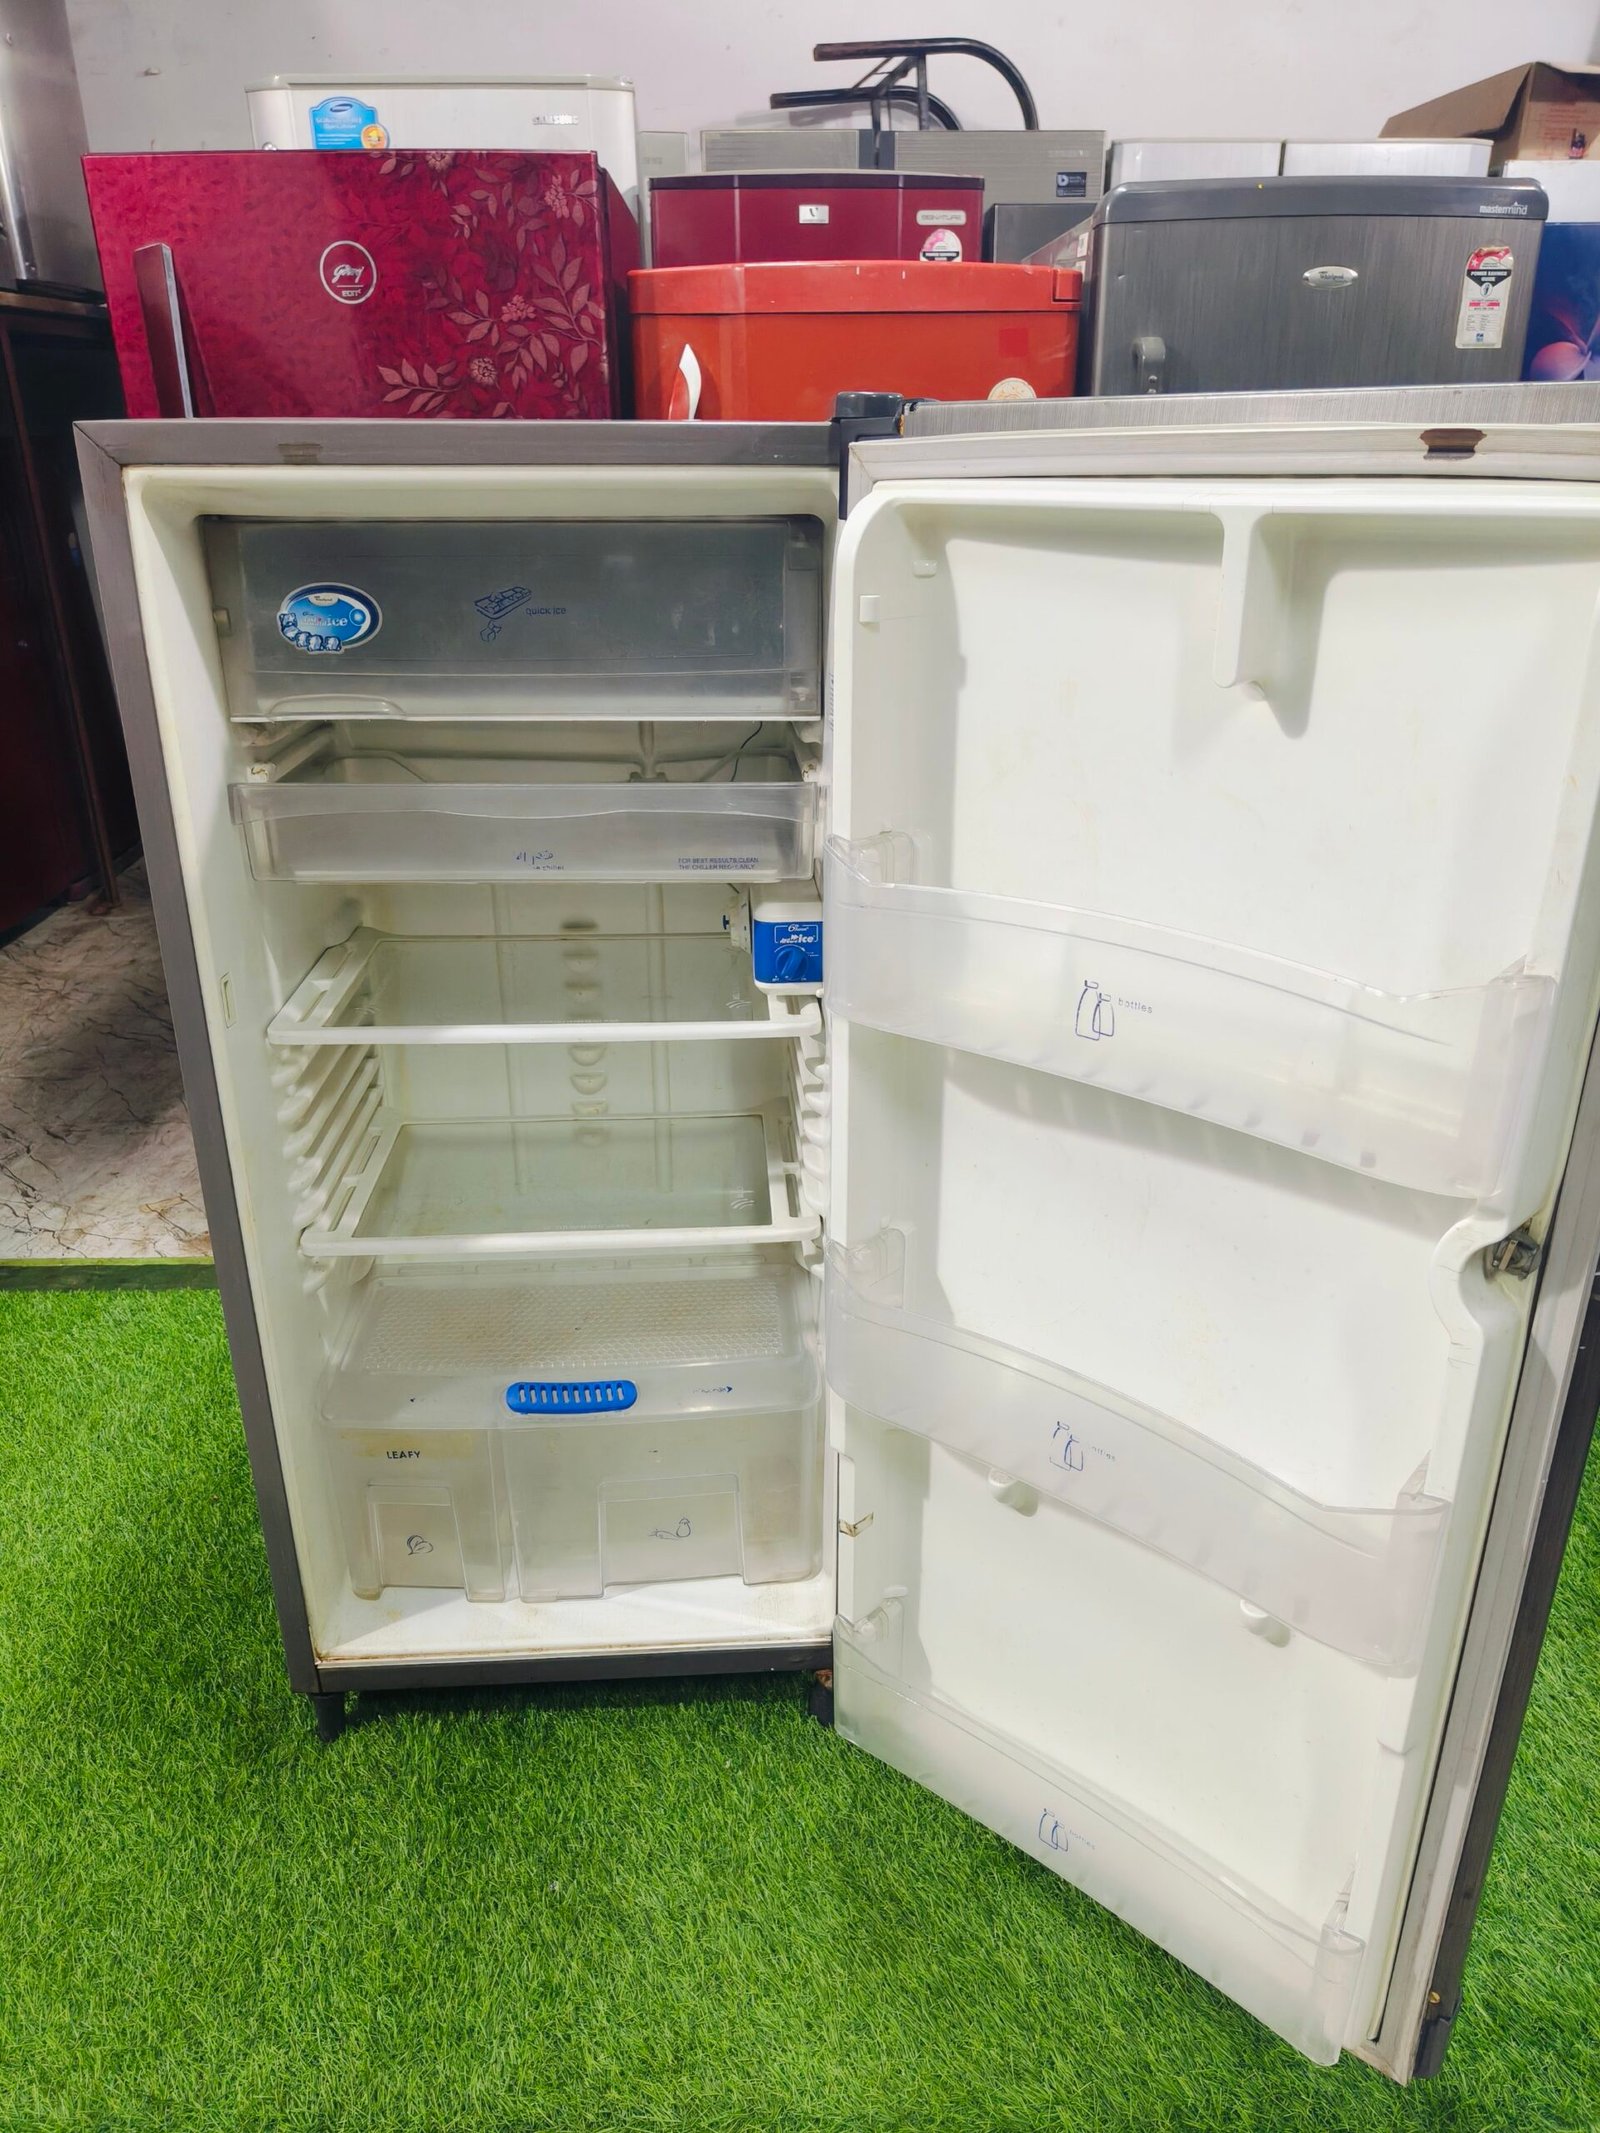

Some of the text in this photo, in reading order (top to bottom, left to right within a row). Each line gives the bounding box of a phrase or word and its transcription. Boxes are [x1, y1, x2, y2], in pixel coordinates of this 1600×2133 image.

[1479, 201, 1529, 215] mastermind
[525, 607, 567, 617] quick ice
[1118, 997, 1154, 1014] bottles
[386, 1450, 421, 1459] LEAFY
